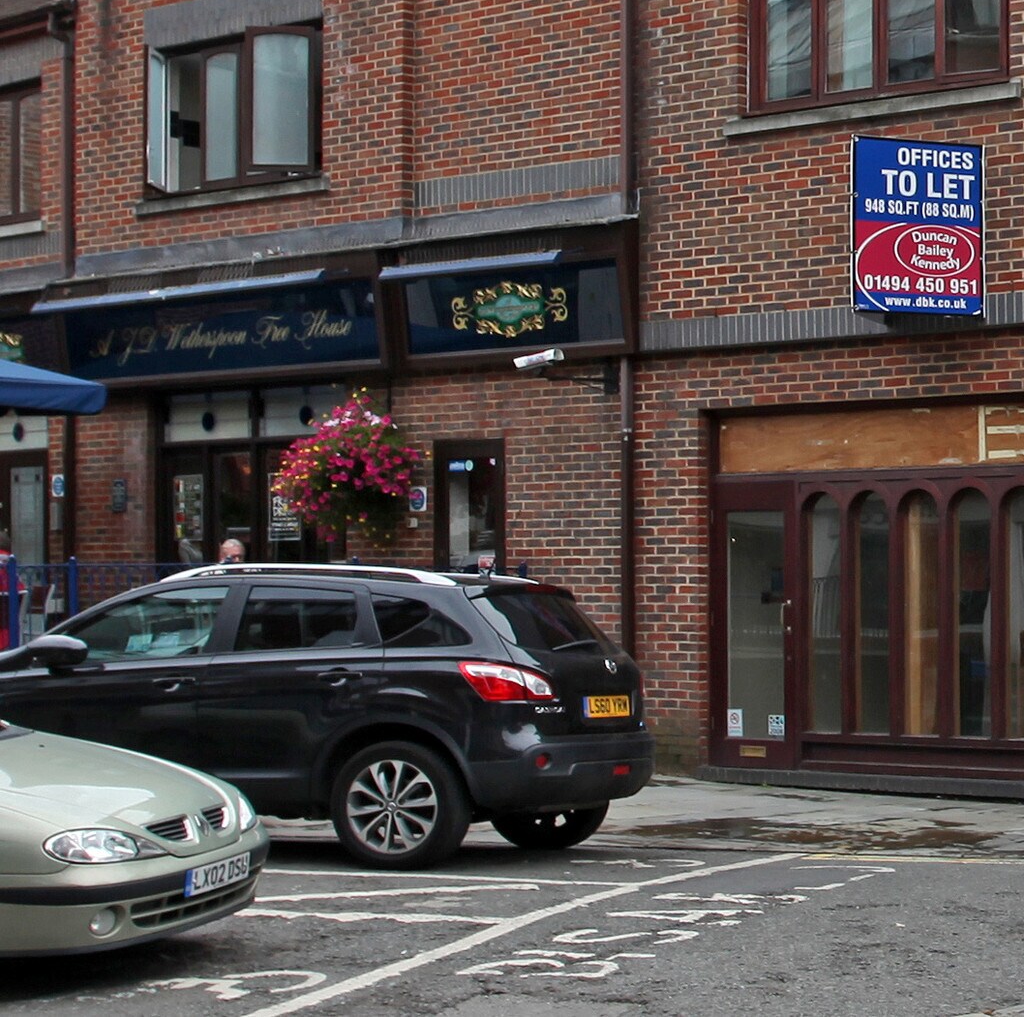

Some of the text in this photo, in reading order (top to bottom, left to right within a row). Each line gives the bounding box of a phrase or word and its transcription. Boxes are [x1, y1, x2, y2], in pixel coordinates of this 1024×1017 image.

[897, 147, 974, 170] OFFICES
[881, 169, 975, 200] TO LET
[865, 198, 975, 222] 948 SQ.FT (88 SQ.M)
[911, 231, 958, 245] Duncan
[910, 255, 960, 270] Kennedy
[917, 244, 954, 259] Bailey
[864, 274, 977, 295] 01494 450 951
[884, 296, 967, 310] www.dbk.co.uk
[251, 315, 290, 349] Free
[294, 309, 352, 350] House
[193, 863, 226, 890] LX02
